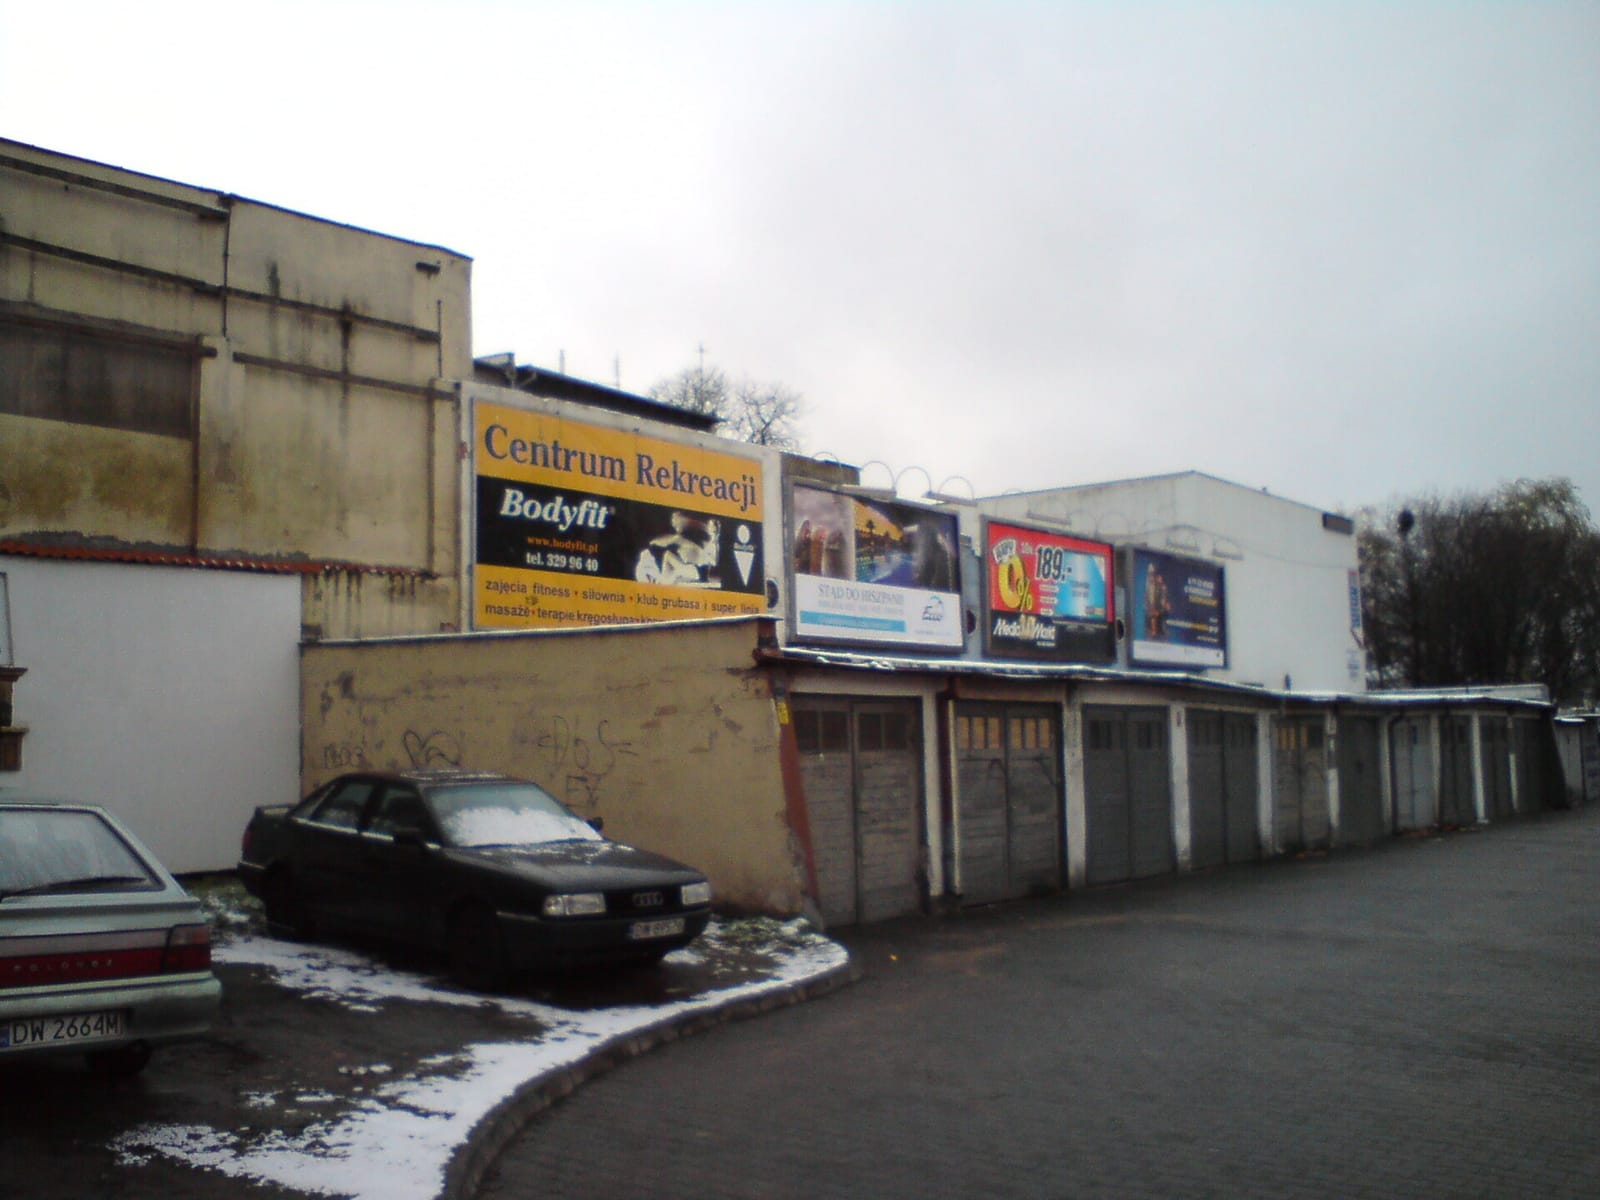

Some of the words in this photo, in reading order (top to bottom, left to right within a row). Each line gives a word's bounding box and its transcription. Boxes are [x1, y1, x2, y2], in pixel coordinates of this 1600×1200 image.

[484, 423, 626, 483] Centrum
[636, 453, 757, 512] Rekreacji
[499, 488, 609, 532] Bodyfit
[525, 552, 544, 566] tel.
[546, 553, 567, 567] 329
[568, 557, 583, 570] 96
[585, 558, 599, 572] 40
[527, 536, 599, 555] www.bodyfit.pl
[485, 580, 528, 594] zajęcia
[532, 582, 571, 598] fitness
[582, 589, 626, 603] siłownia
[636, 593, 659, 606] klub
[661, 596, 700, 610] grubasa
[711, 602, 737, 615] super
[485, 602, 529, 617] masaże
[537, 607, 575, 622] terapie
[12, 1021, 46, 1045] DW
[53, 1012, 120, 1040] 2664M
